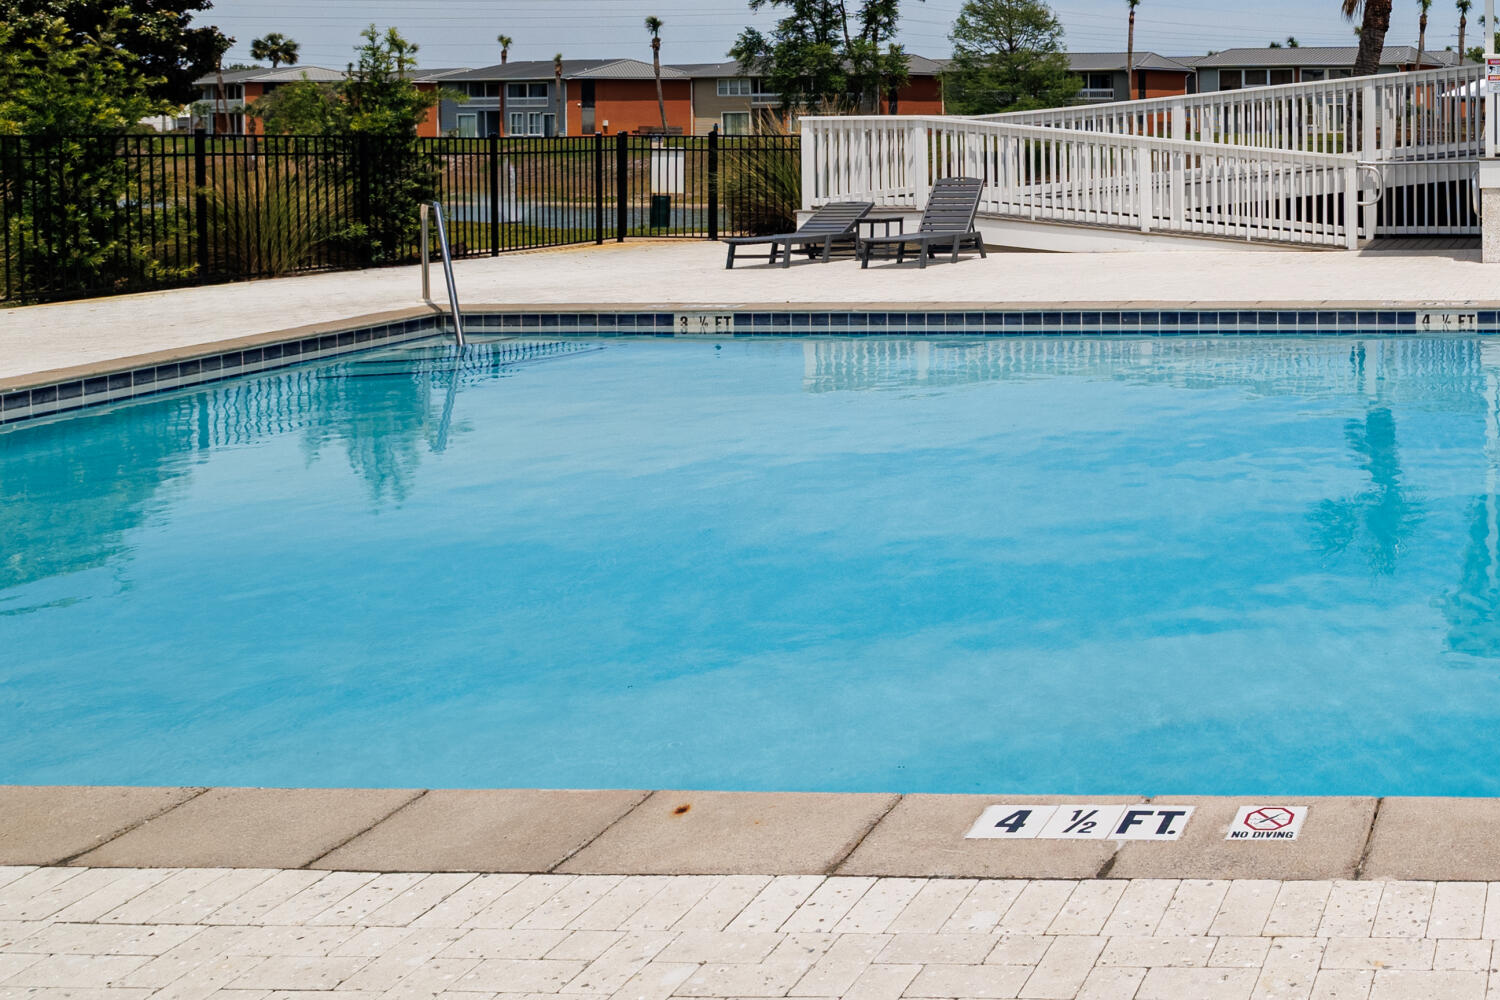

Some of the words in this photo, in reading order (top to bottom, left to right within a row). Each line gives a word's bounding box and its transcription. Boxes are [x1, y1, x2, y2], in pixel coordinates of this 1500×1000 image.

[715, 315, 732, 326] FT
[1422, 313, 1430, 324] 4
[1458, 314, 1475, 324] FT
[994, 810, 1032, 832] 4
[1252, 831, 1294, 839] DIVING
